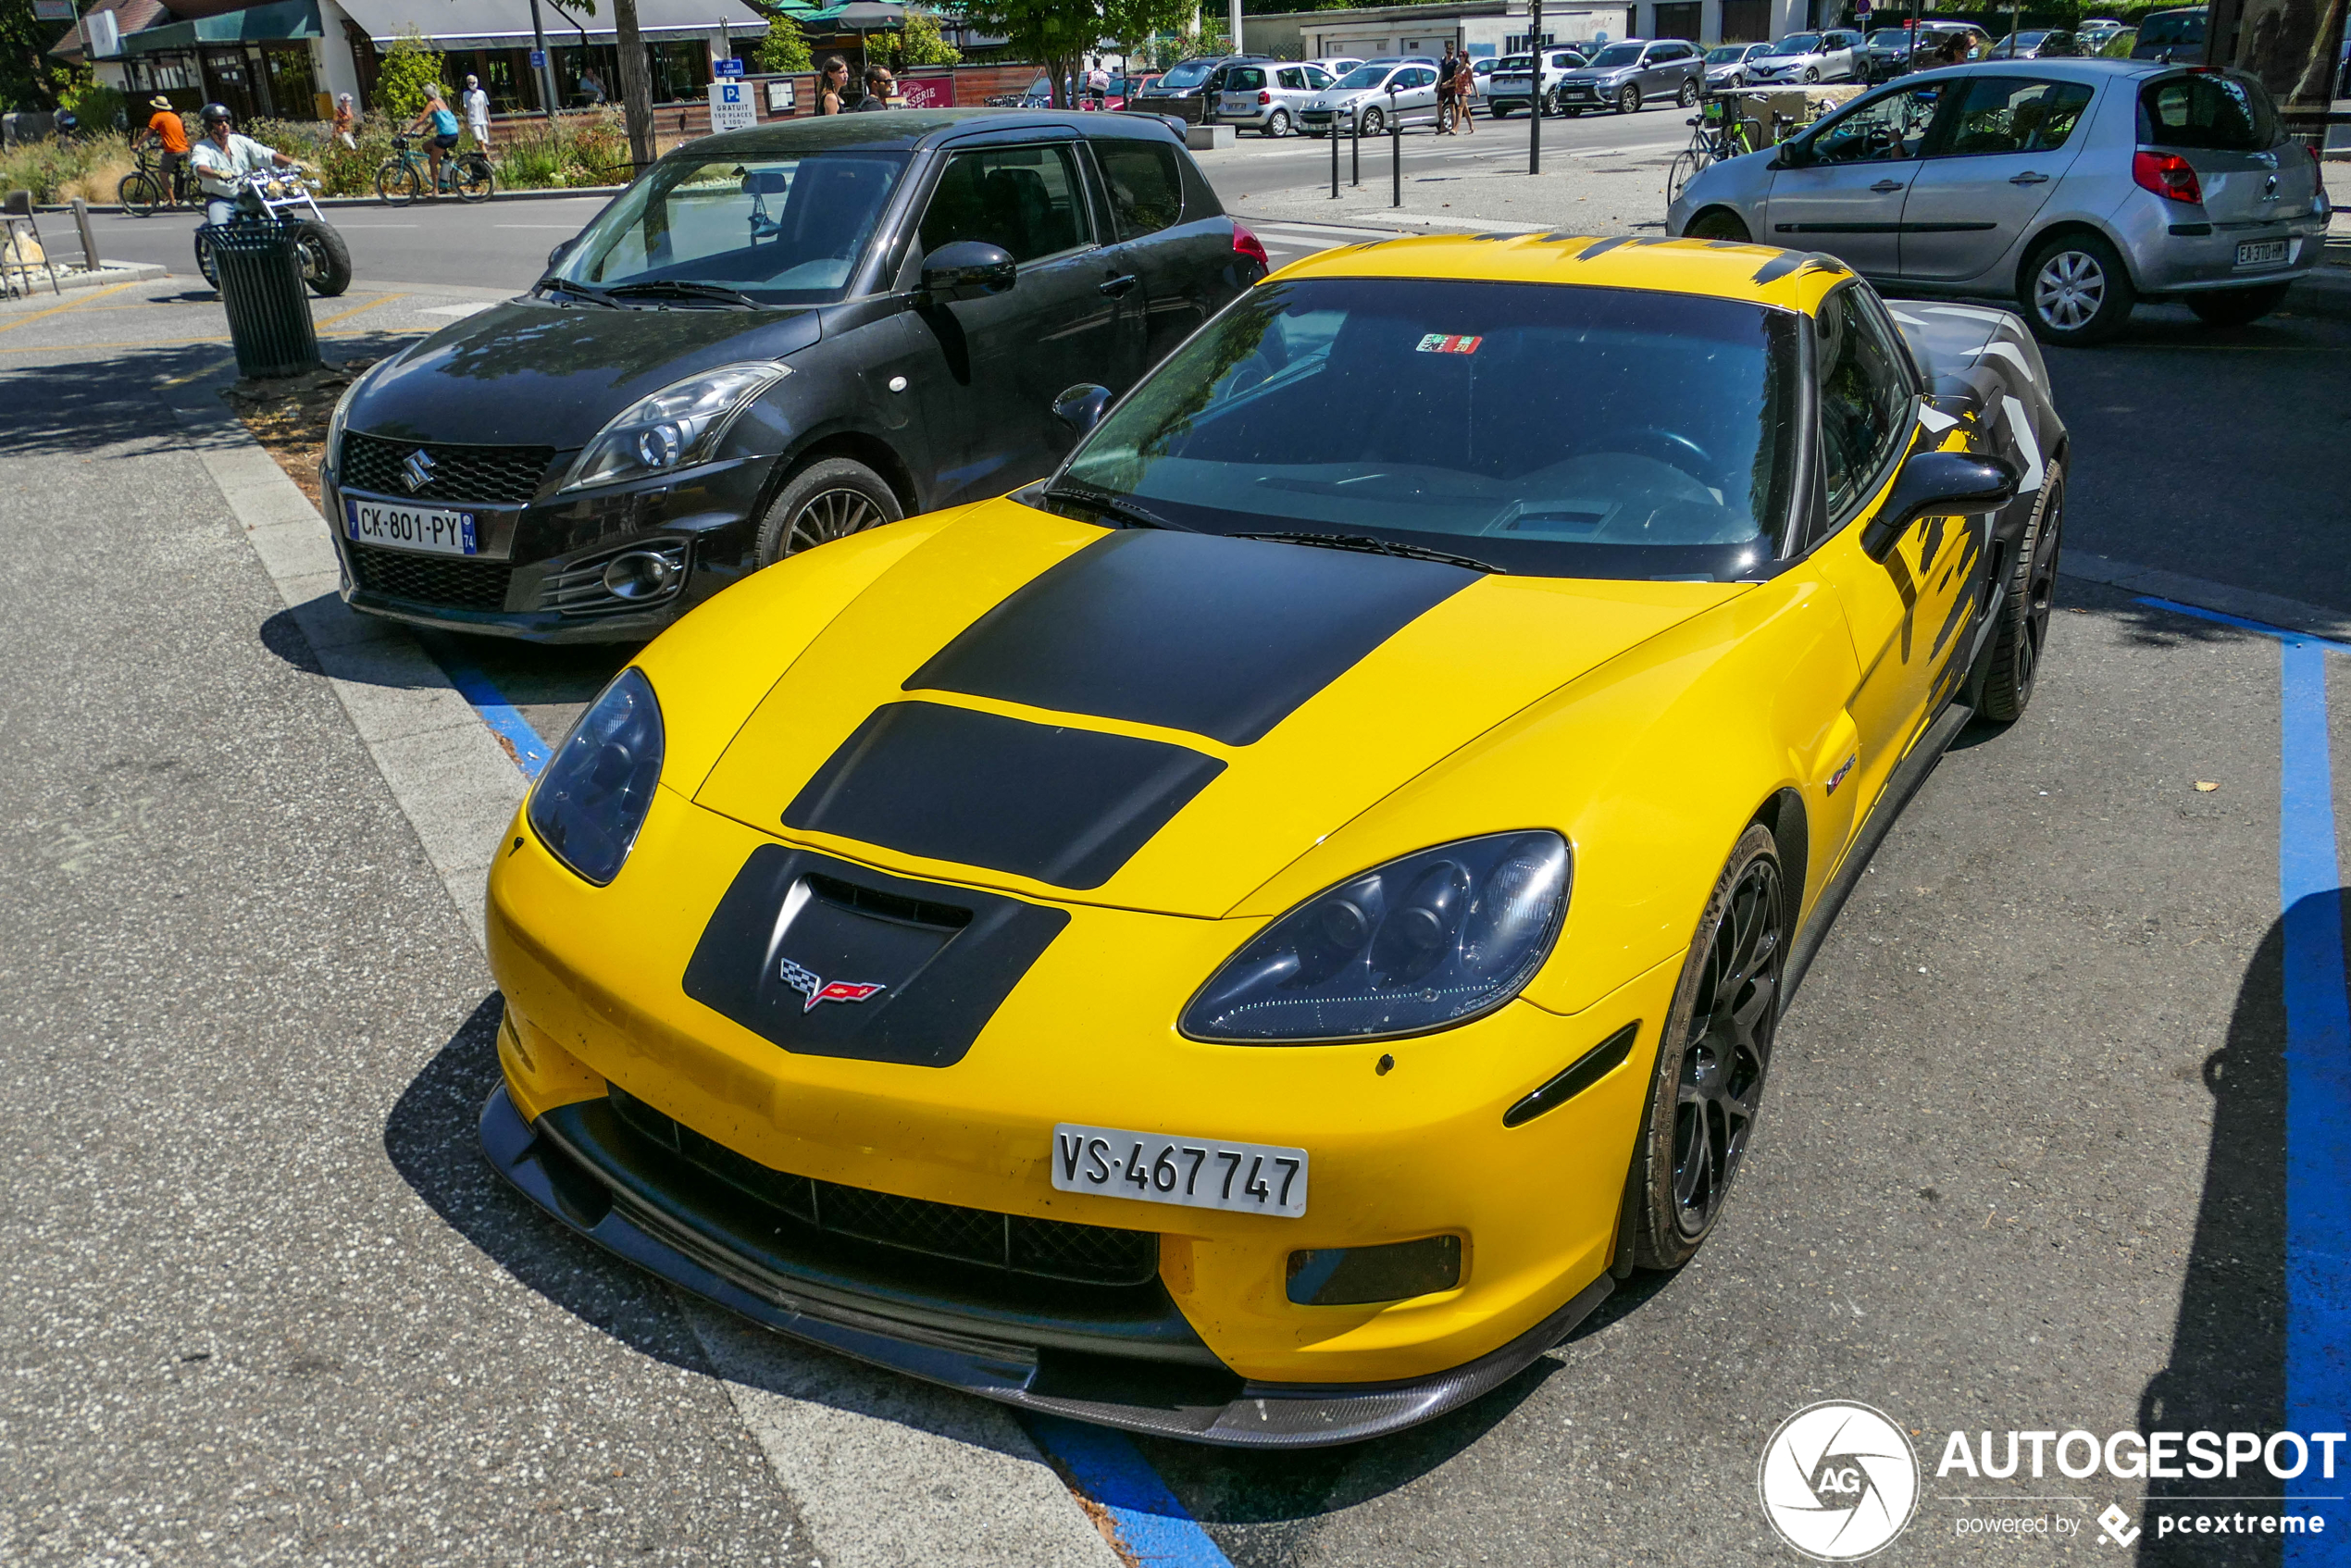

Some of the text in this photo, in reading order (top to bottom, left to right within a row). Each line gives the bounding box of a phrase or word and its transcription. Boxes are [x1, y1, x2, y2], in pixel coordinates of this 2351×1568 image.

[1453, 343, 1470, 352] 20
[361, 507, 456, 546] CK-801-PY
[464, 534, 474, 549] 74
